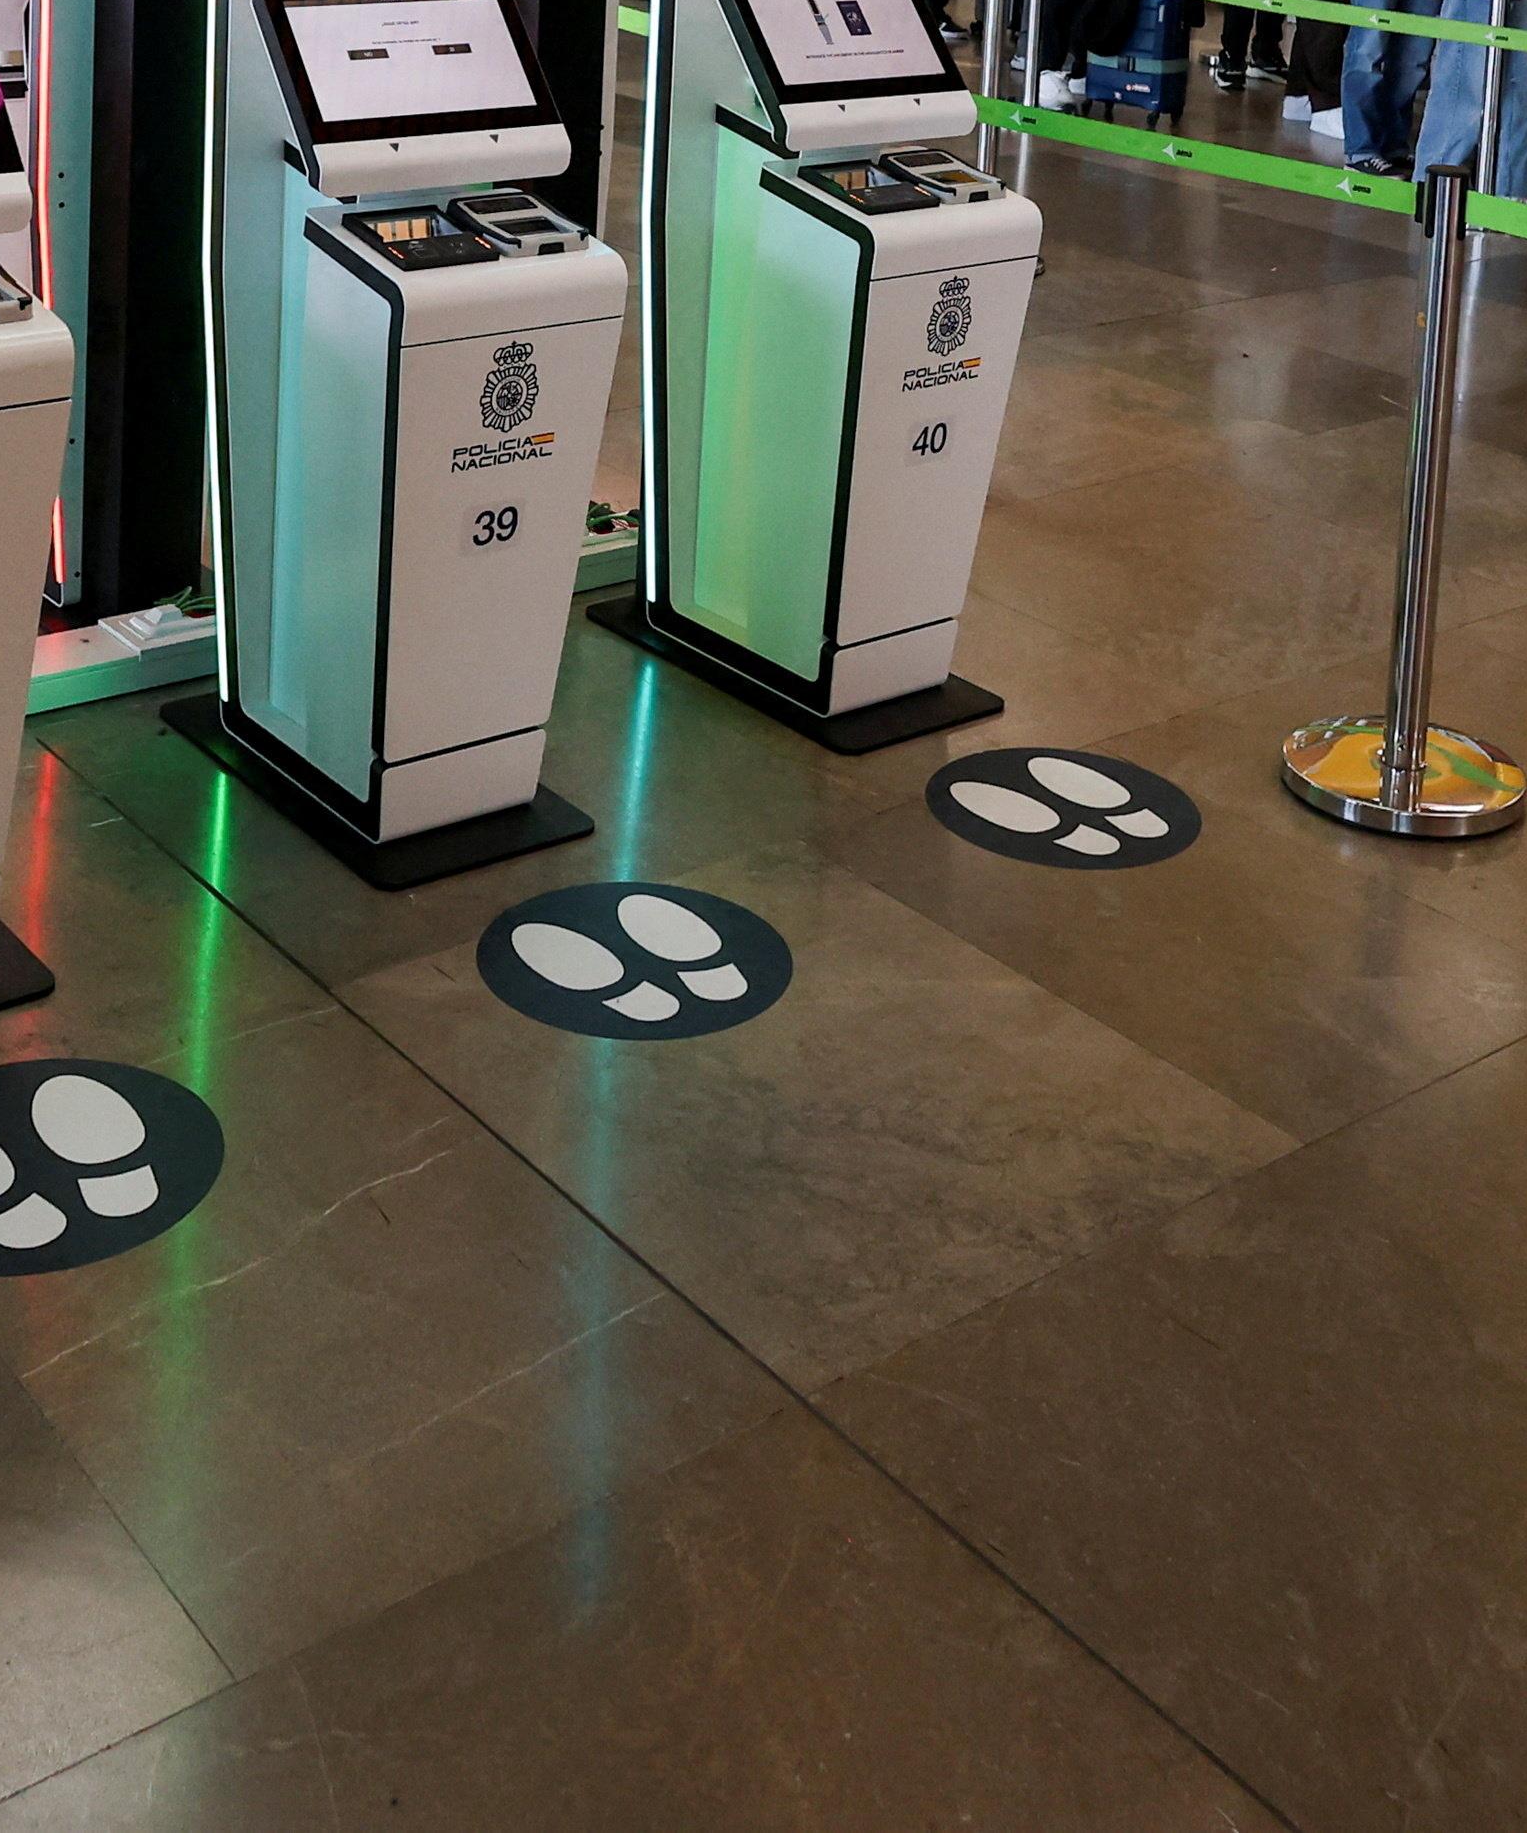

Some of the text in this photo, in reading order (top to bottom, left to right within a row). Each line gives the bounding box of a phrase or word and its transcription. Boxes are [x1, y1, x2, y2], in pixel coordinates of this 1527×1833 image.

[902, 371, 978, 392] NACIONAL
[904, 361, 964, 381] POLICIA
[453, 436, 533, 460] POLICIA
[912, 422, 947, 456] 40
[451, 447, 552, 473] NACIONAL
[473, 506, 518, 546] 39
